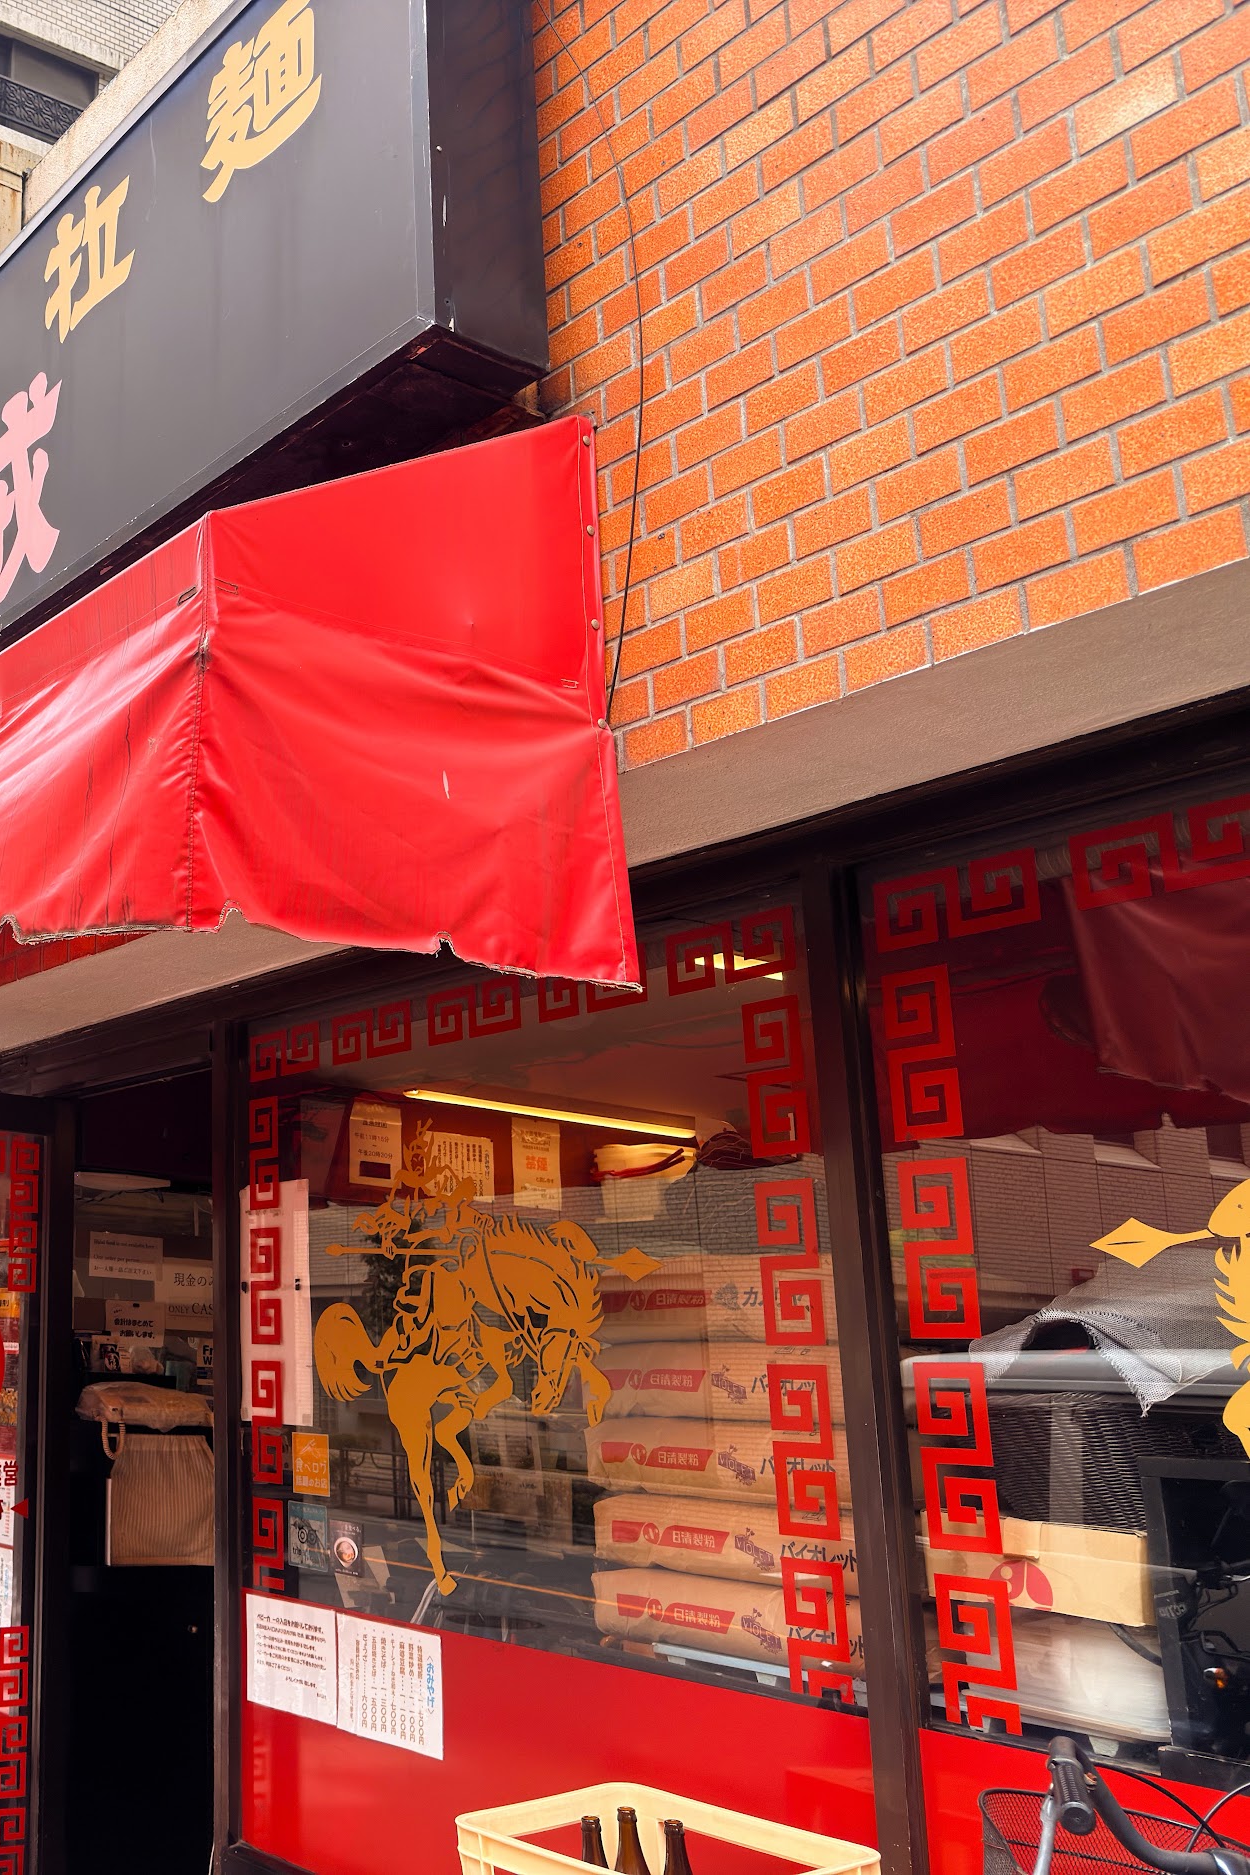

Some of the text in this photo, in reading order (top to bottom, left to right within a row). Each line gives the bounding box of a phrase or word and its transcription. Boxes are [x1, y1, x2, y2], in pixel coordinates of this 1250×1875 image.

[168, 1305, 190, 1314] ONLY
[650, 1372, 694, 1388] 日清製粉
[712, 1373, 747, 1399] VIOLET
[295, 1457, 327, 1475] 食べログ
[657, 1450, 700, 1467] 日清製粉
[718, 1454, 755, 1479] VIOLET
[760, 1455, 836, 1475] バオレット
[672, 1533, 716, 1549] 日清製粉
[735, 1536, 775, 1565] VIOLET
[780, 1541, 857, 1572] バイオレット
[673, 1608, 720, 1628] 日清製粉
[741, 1616, 782, 1649] VIOLET
